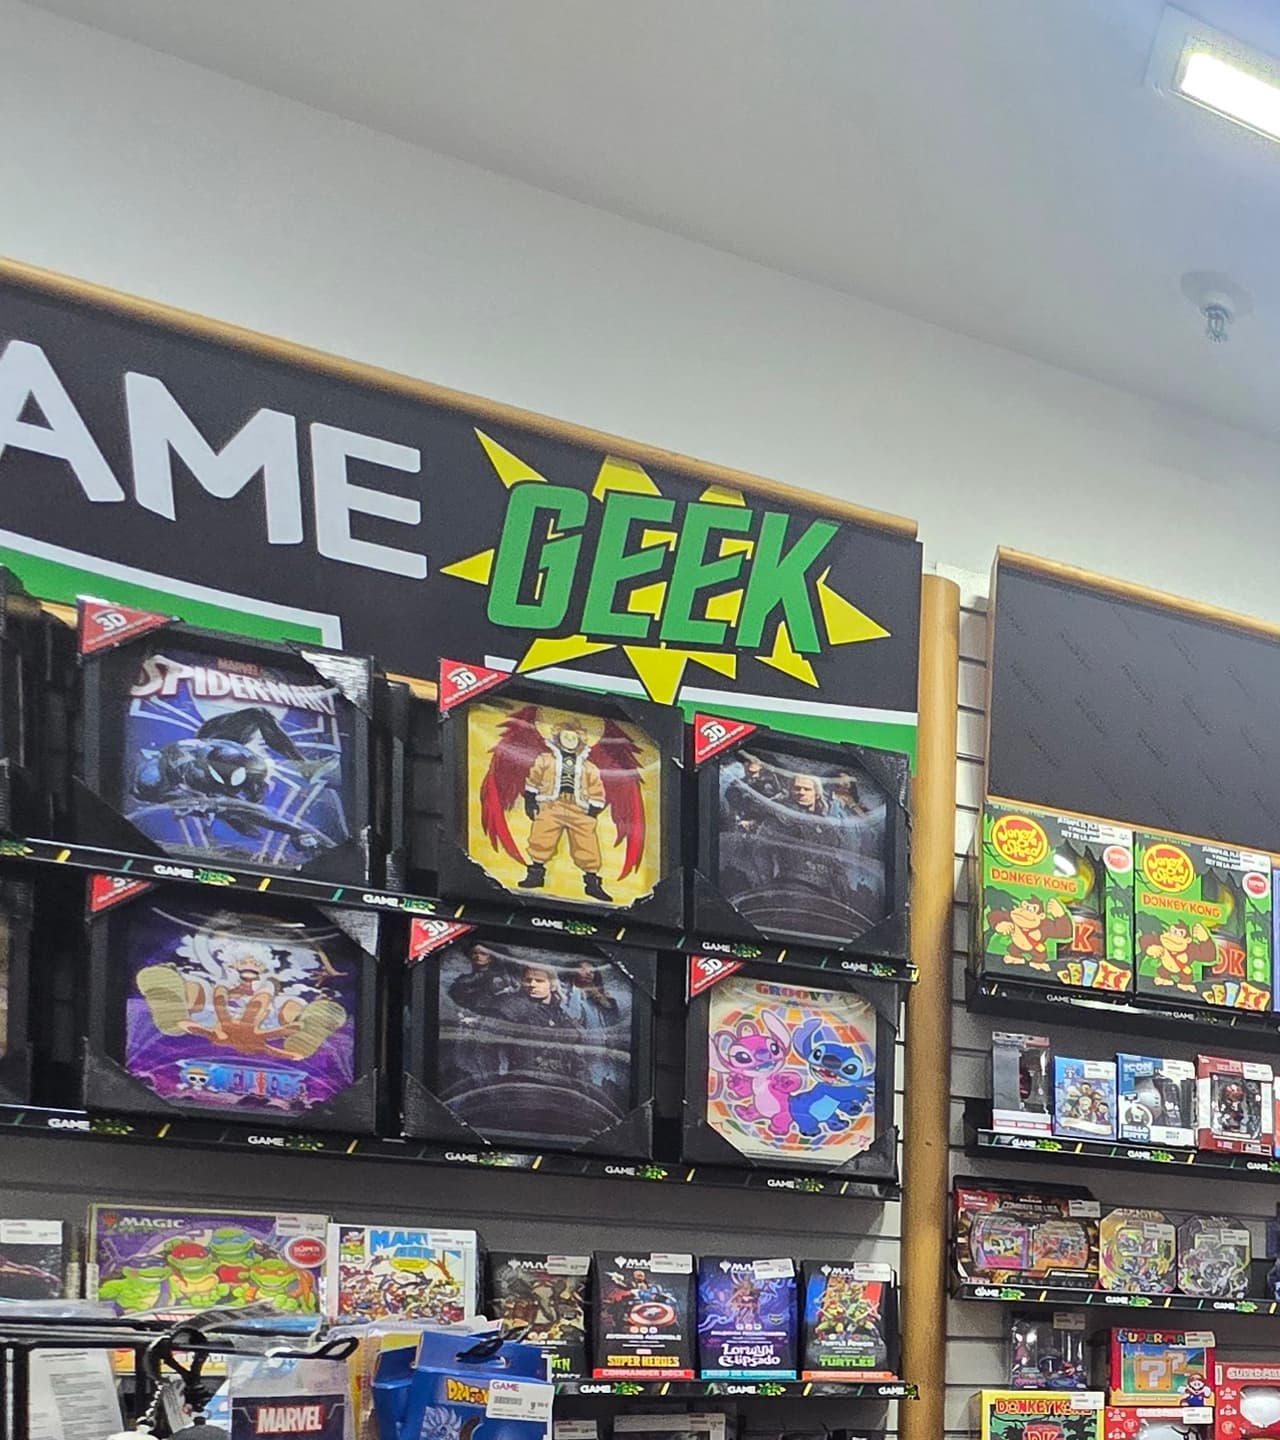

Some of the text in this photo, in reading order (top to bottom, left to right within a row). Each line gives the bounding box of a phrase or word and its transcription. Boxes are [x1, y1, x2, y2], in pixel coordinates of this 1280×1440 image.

[0, 339, 840, 653] AME GEEK
[96, 613, 128, 633] 3D
[448, 669, 479, 692] 3D
[705, 722, 728, 743] 3D
[992, 868, 1077, 893] DONKEY KONG
[1142, 893, 1221, 918] DONKEY KONG
[120, 1216, 186, 1230] MAGIC
[819, 1355, 875, 1367] TURTLES
[492, 1382, 520, 1393] GAME
[995, 1399, 1052, 1415] DONKEY
[257, 1405, 323, 1433] MARVEL
